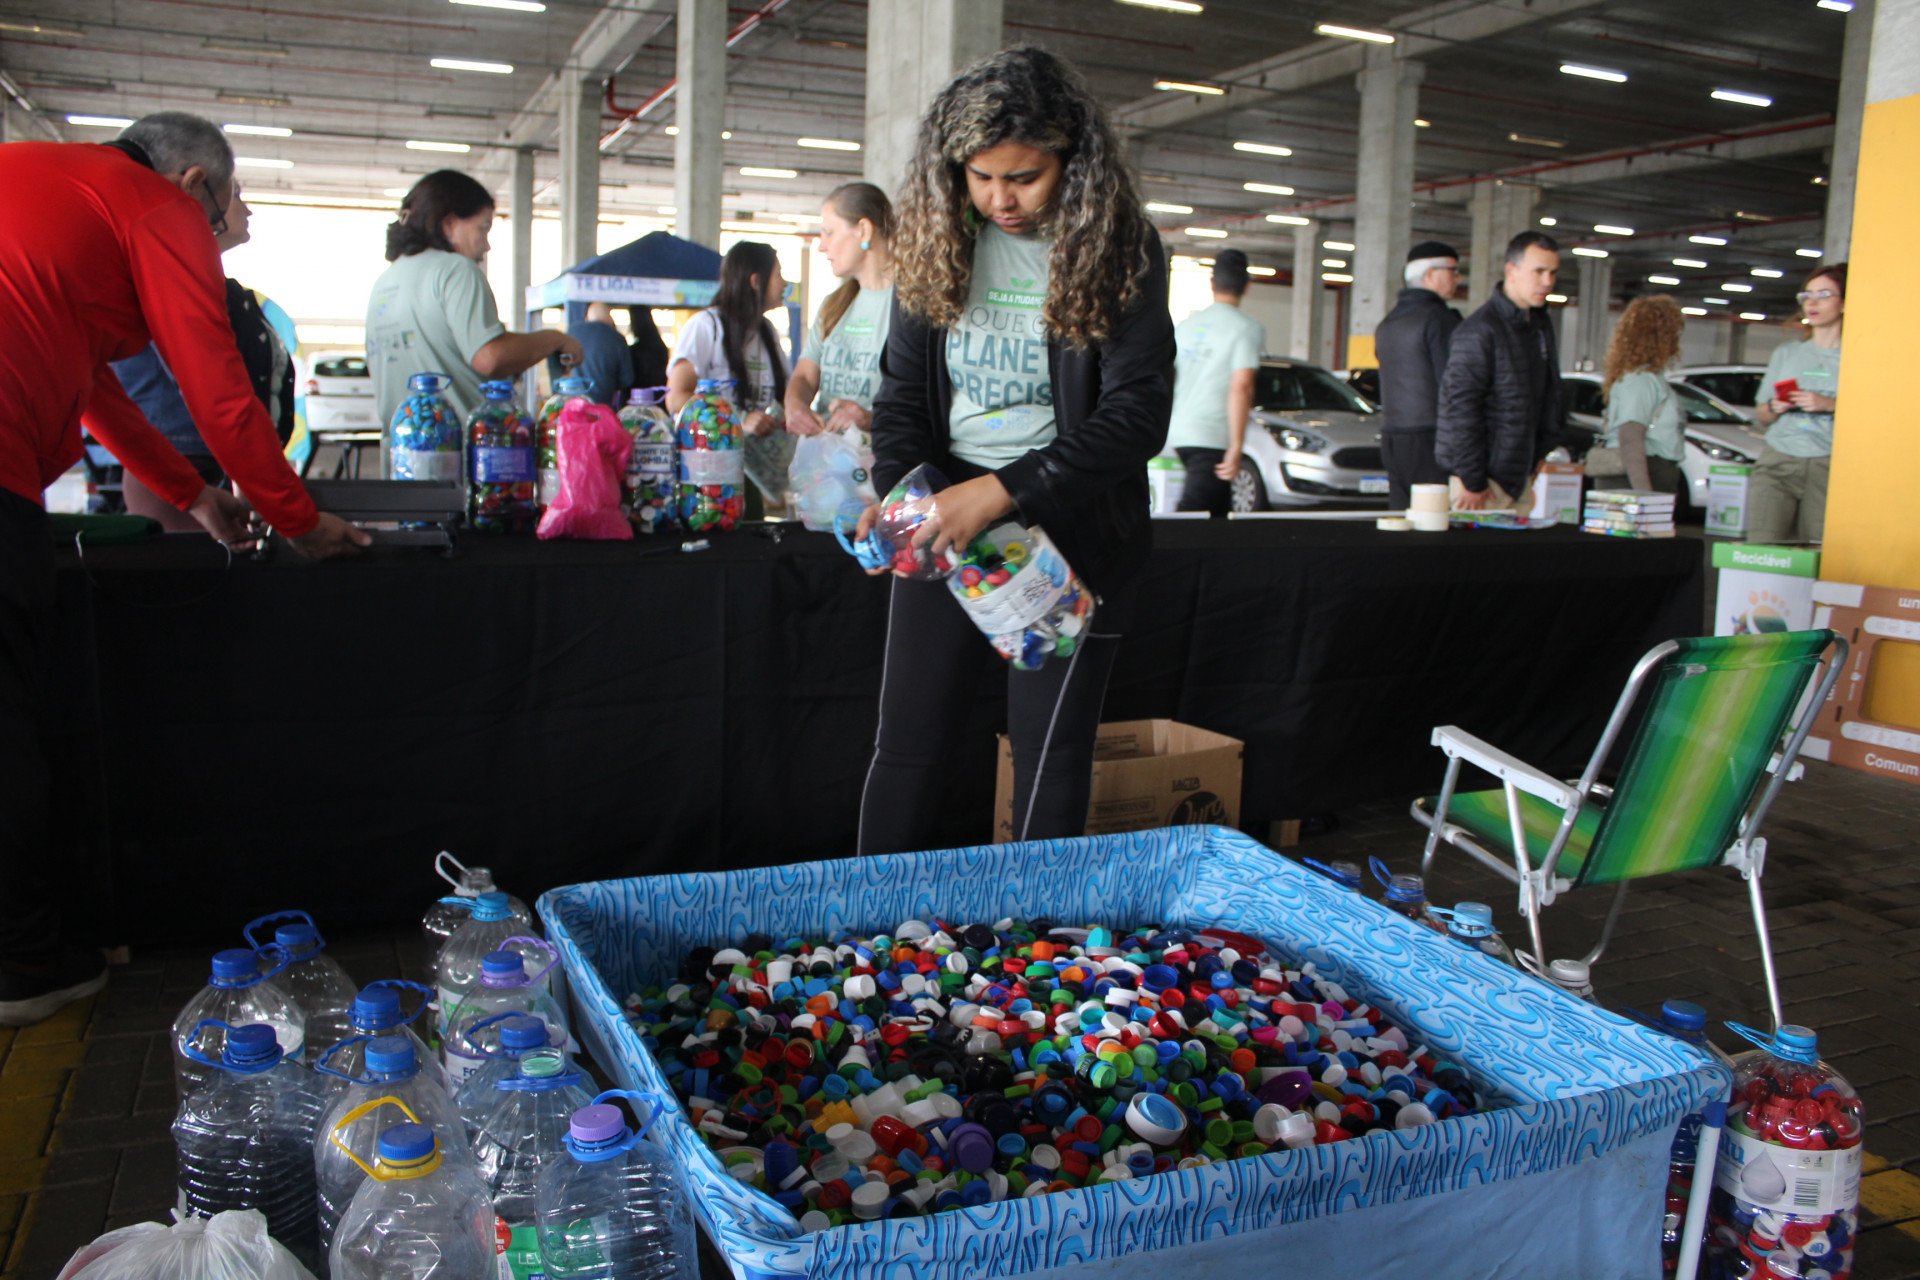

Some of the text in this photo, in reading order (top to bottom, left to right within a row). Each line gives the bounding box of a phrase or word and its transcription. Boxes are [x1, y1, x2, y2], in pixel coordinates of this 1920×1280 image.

[575, 275, 593, 290] TE
[598, 277, 634, 291] LIGA
[988, 291, 1046, 307] SEJA A MUDANÇ
[970, 306, 1026, 333] QUE
[947, 330, 1049, 375] PLANE
[950, 368, 1054, 410] PRECIS
[1732, 551, 1792, 568] Reciclável
[1865, 753, 1919, 776] Comum
